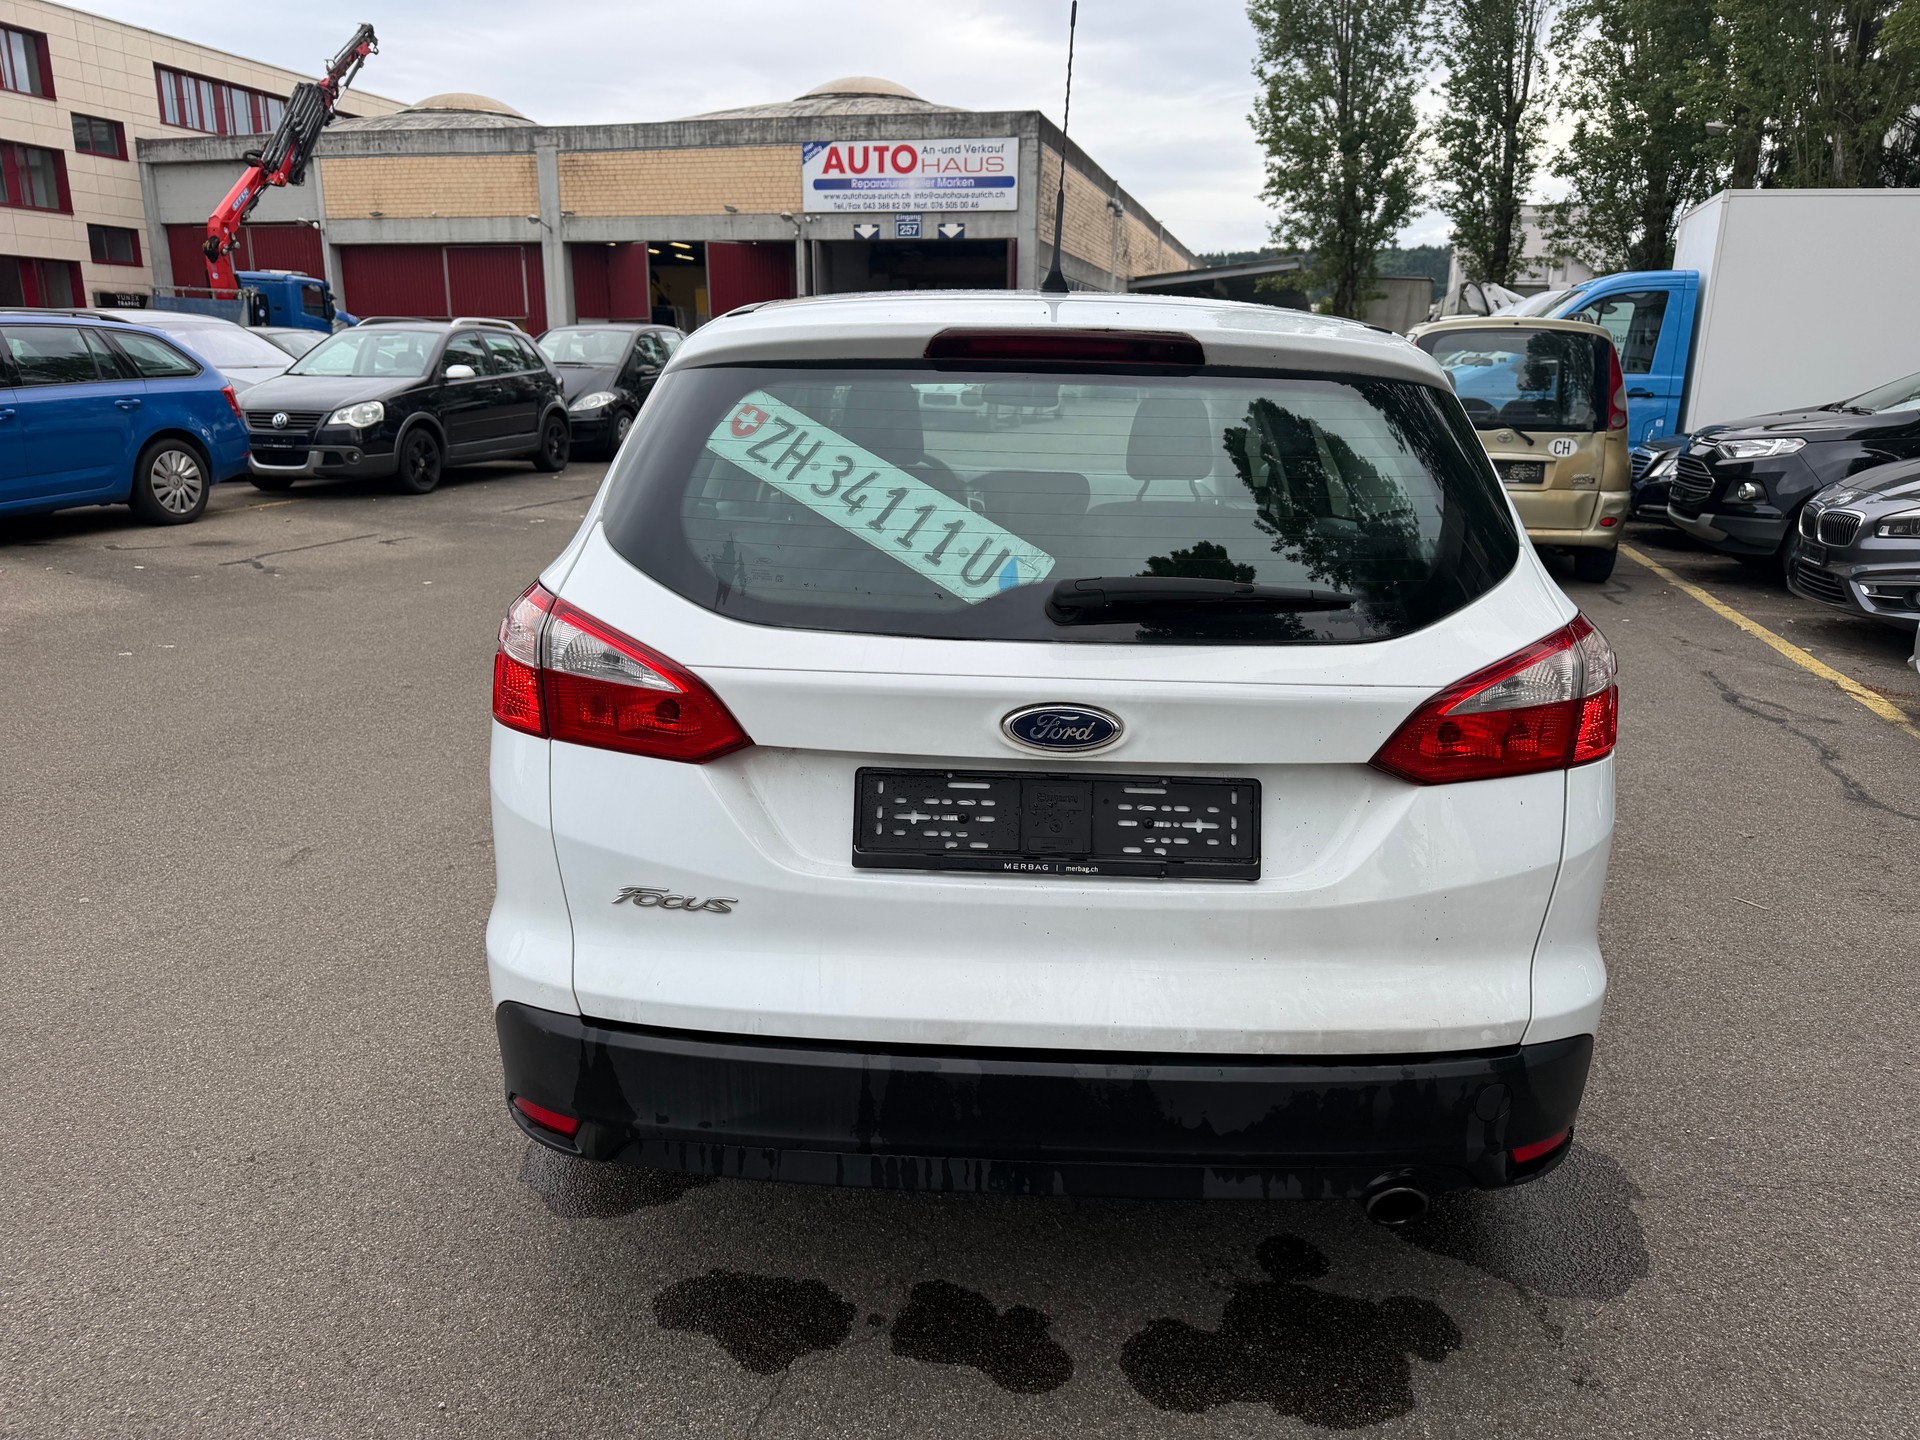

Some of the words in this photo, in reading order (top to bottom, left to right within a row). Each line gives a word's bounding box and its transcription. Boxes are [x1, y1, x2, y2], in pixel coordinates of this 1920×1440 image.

[964, 144, 1004, 154] Verkauf
[822, 144, 918, 174] AUTO
[921, 156, 1004, 174] HAUS
[937, 177, 975, 187] Marken
[899, 225, 917, 235] 257
[1553, 440, 1571, 455] CH
[1029, 713, 1096, 740] Ford
[1003, 862, 1049, 871] MERBAG
[1065, 865, 1099, 873] merbag.ch
[611, 884, 738, 914] Focus
